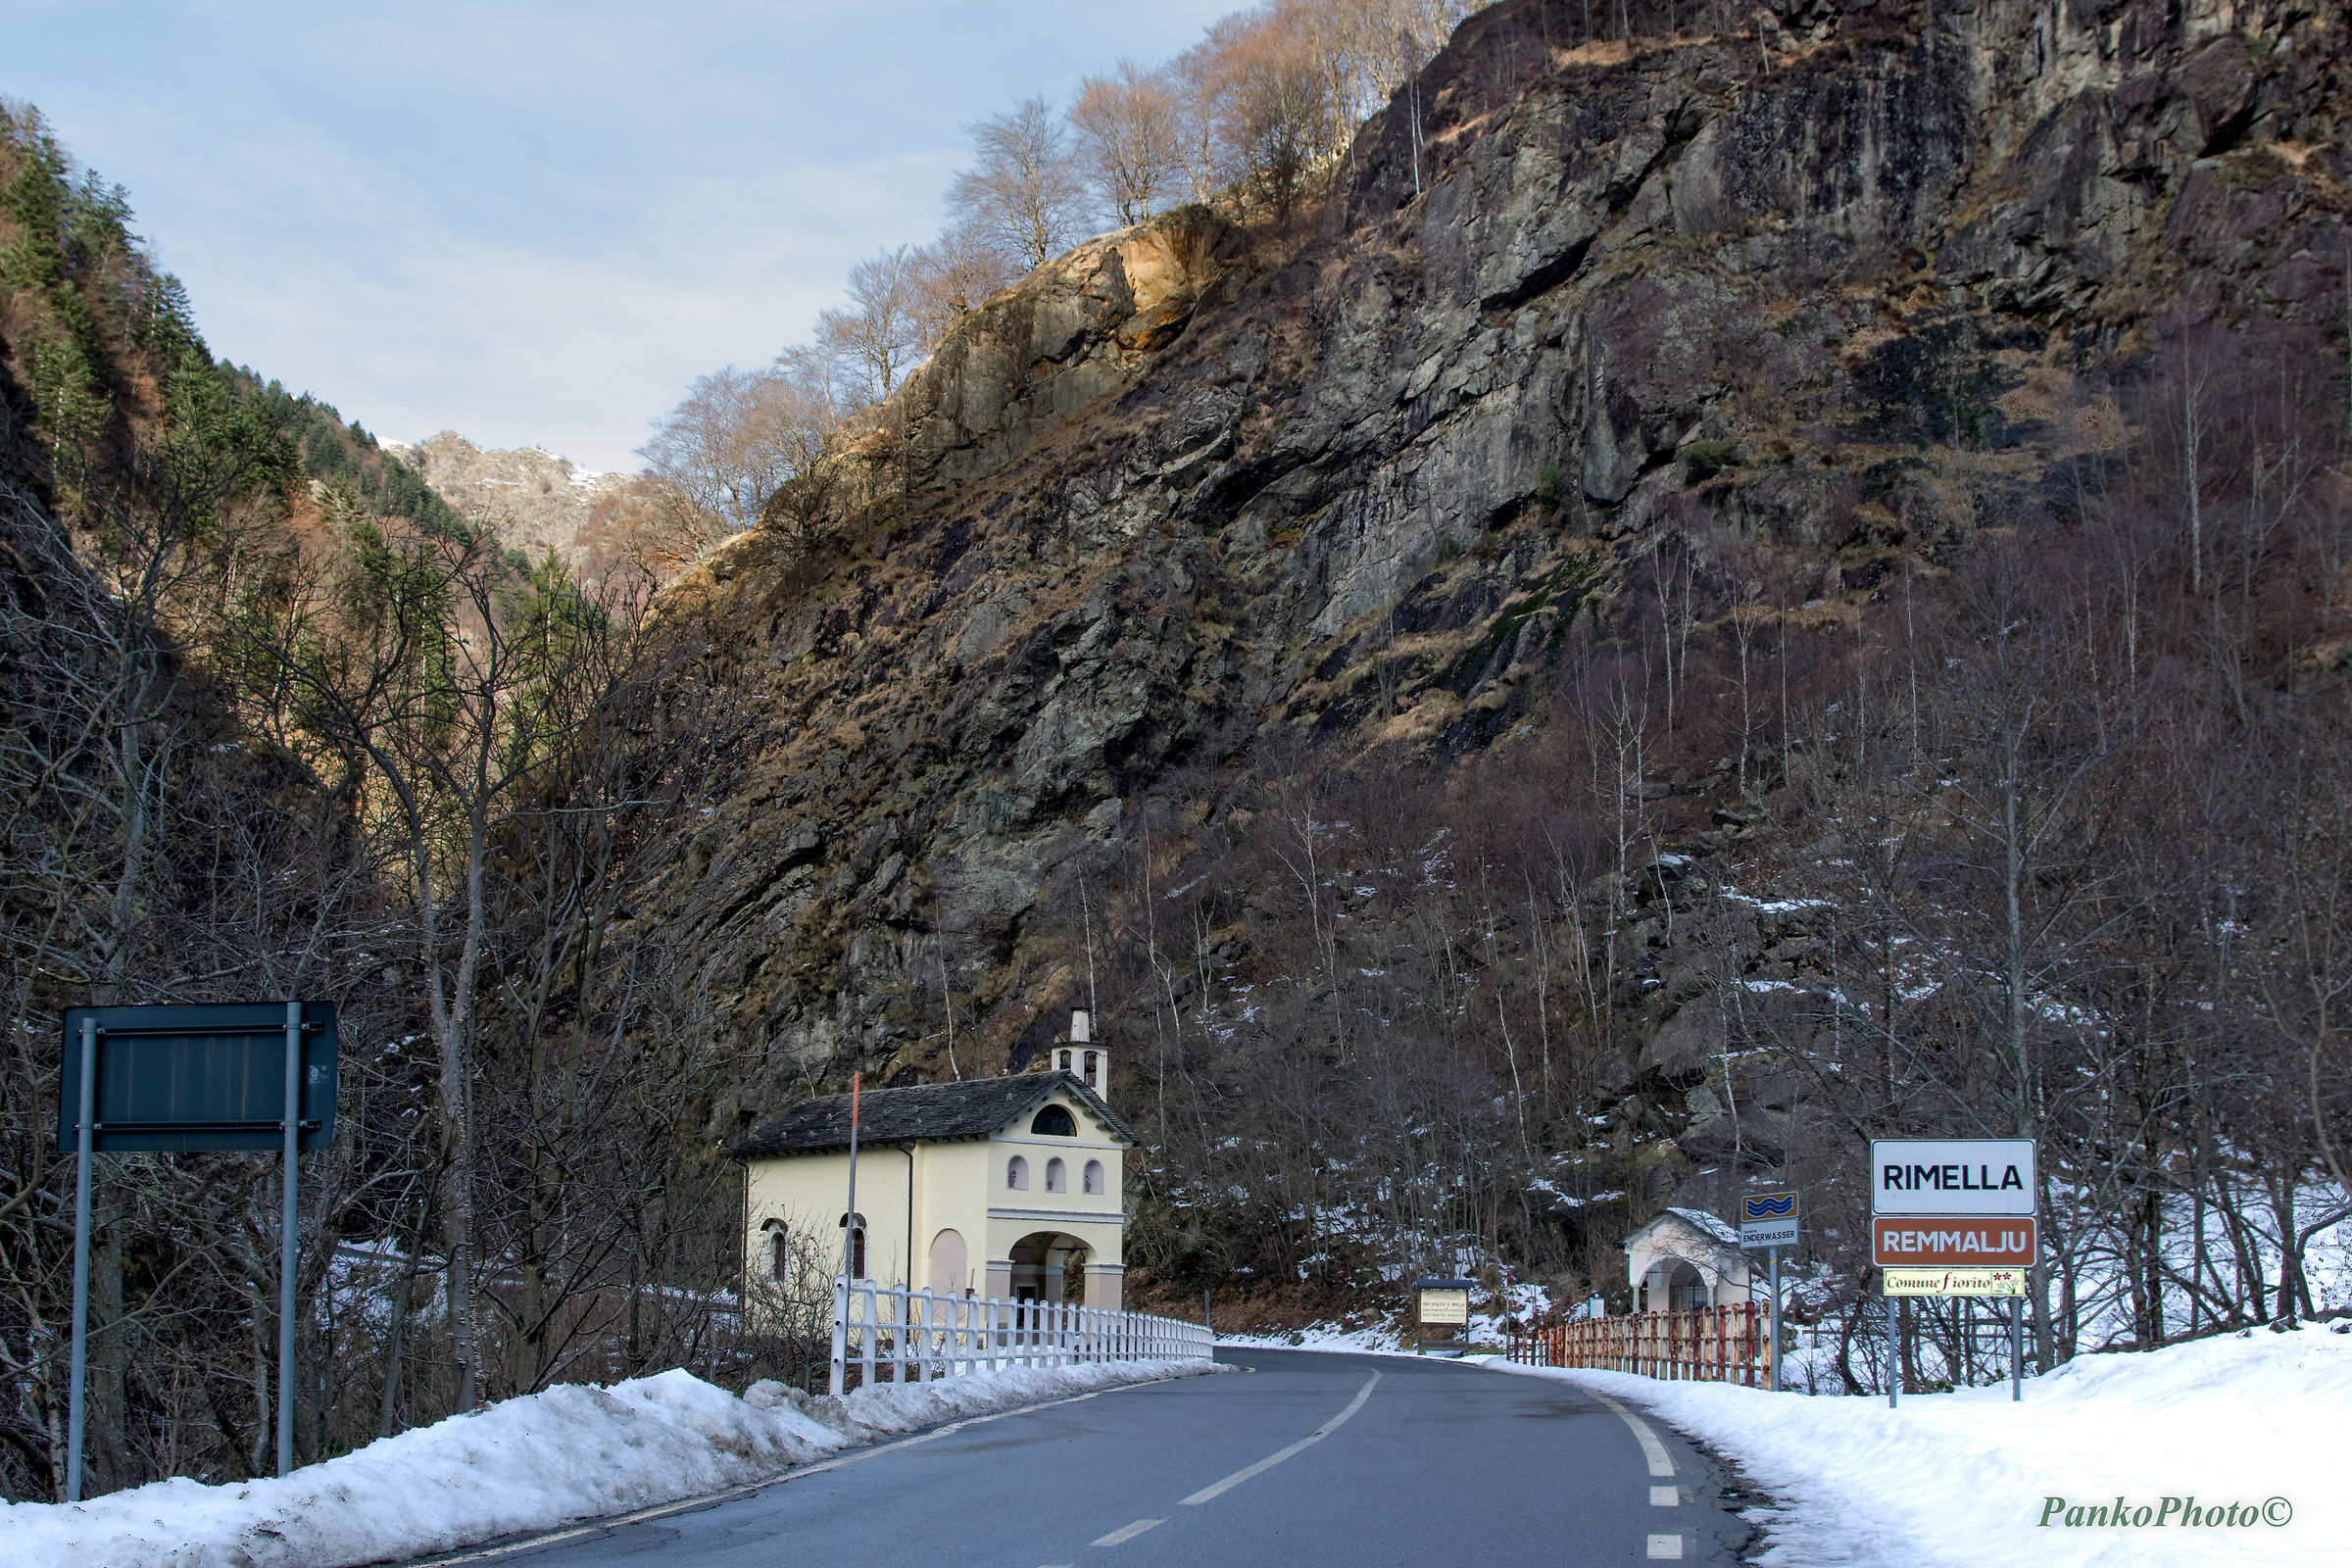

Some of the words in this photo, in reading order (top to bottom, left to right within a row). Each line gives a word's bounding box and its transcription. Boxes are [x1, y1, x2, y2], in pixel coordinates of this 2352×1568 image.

[1884, 1165, 2024, 1190] RIMELLA
[1742, 1230, 1795, 1243] ENDERWASSER
[1884, 1232, 2027, 1253] REMMALJU
